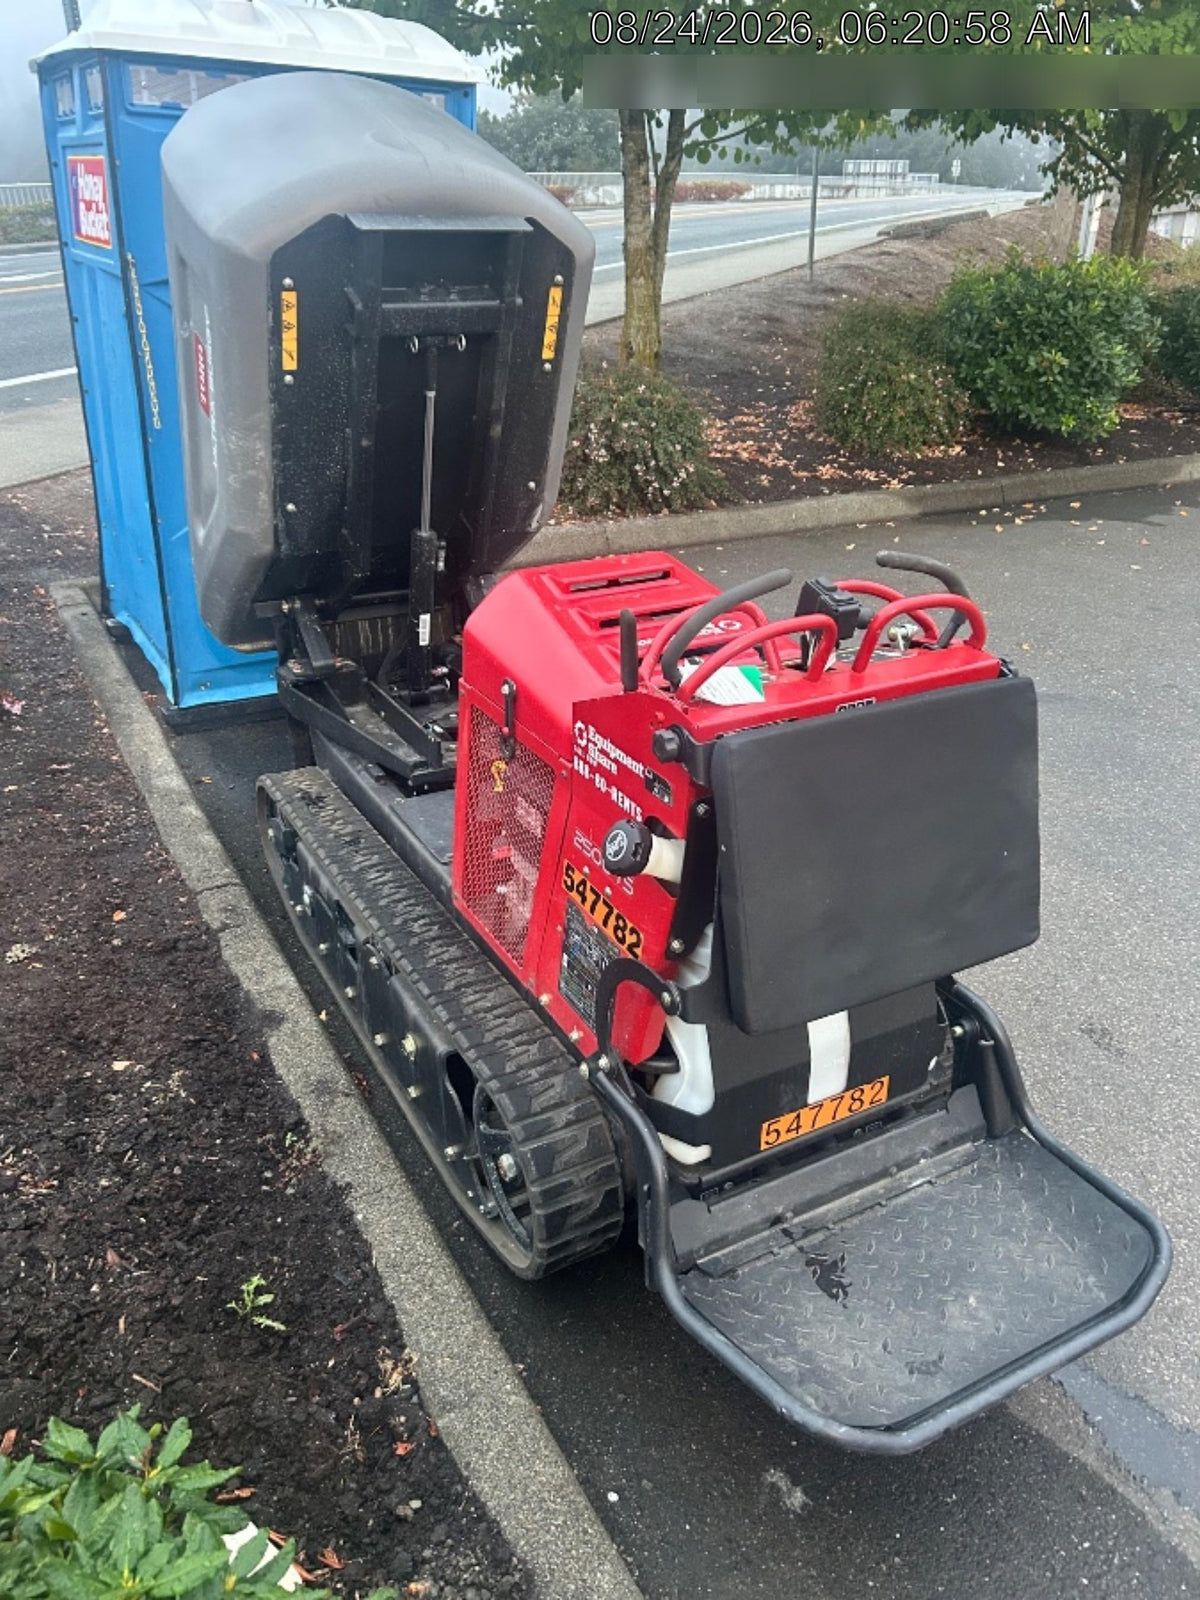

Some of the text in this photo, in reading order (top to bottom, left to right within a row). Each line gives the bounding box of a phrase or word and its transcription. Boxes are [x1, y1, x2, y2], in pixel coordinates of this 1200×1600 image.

[78, 162, 104, 204] Honey
[80, 201, 111, 241] Bucket
[587, 724, 645, 779] Equipment
[587, 741, 618, 776] Share
[563, 861, 642, 960] 547782
[765, 1080, 885, 1146] 547782
